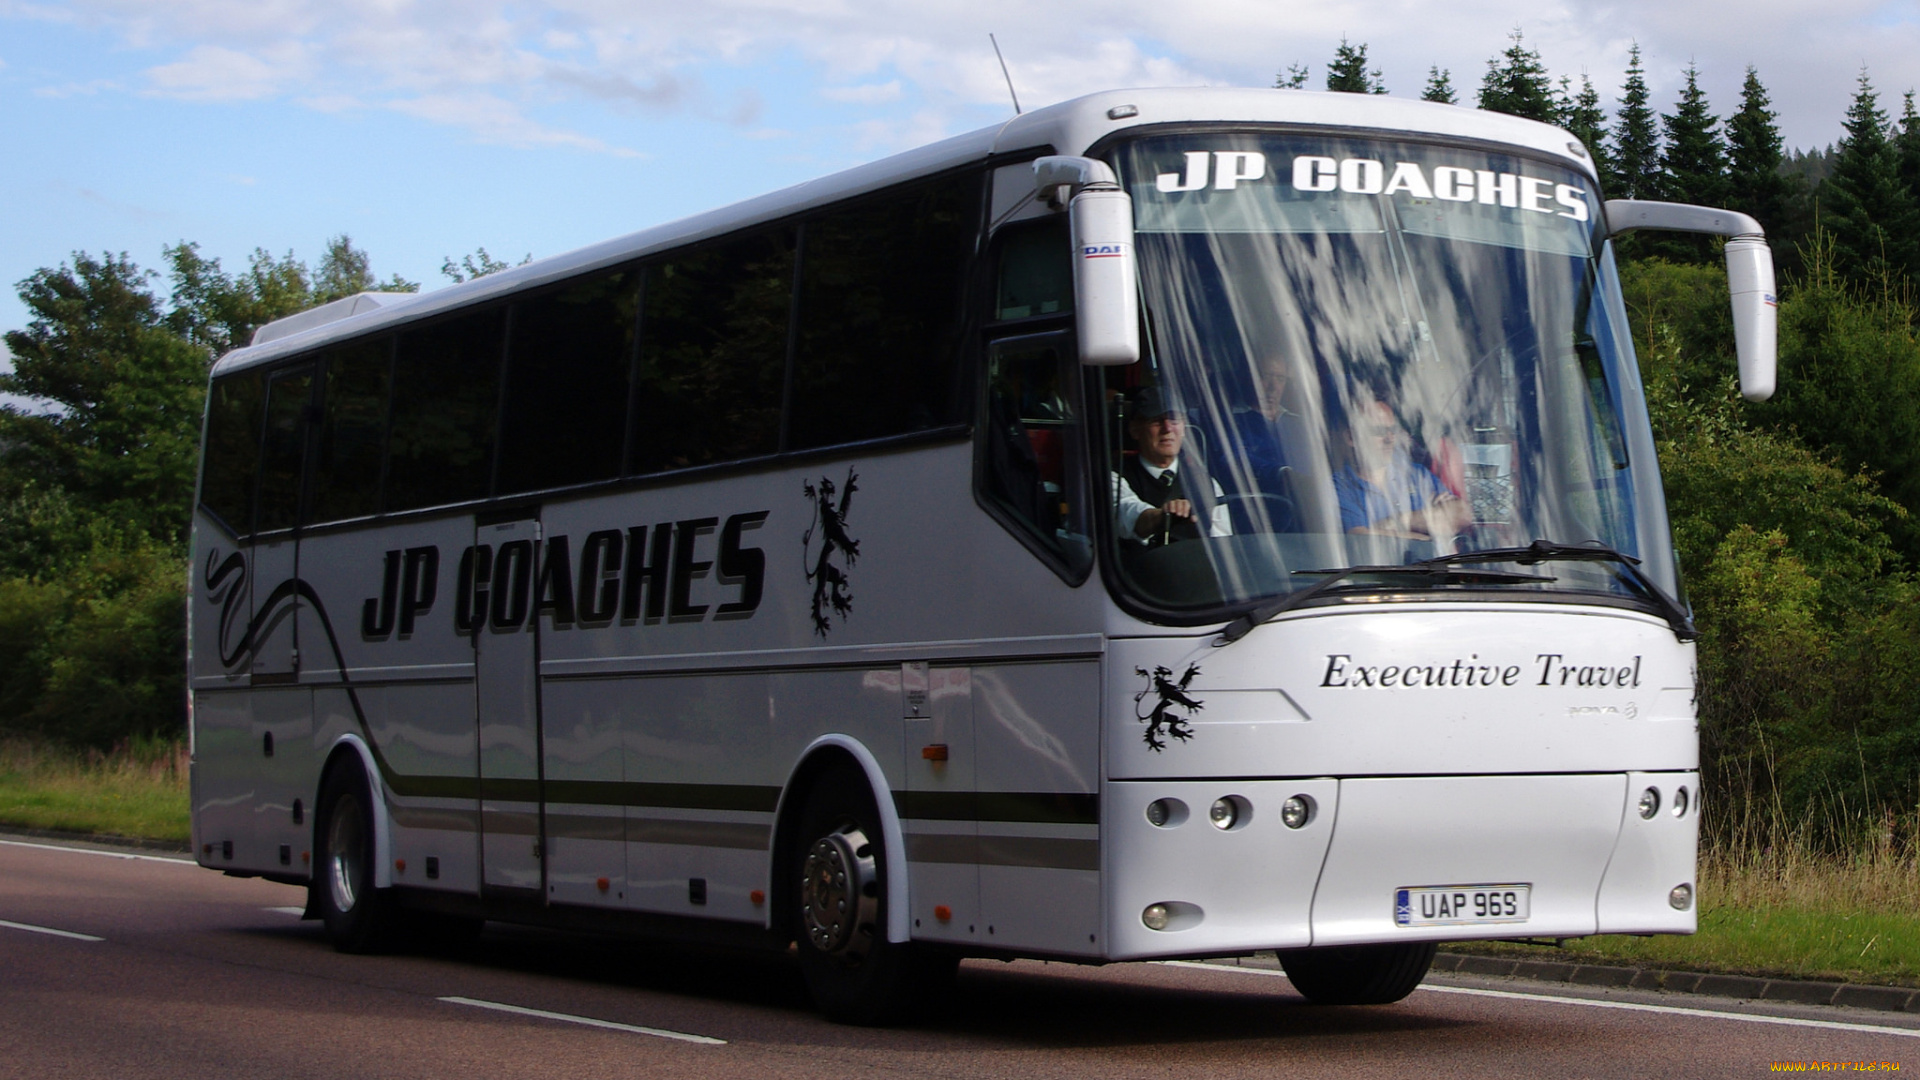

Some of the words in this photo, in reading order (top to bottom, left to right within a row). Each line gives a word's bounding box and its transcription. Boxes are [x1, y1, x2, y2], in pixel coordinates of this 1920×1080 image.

[1156, 151, 1266, 193] JP
[1292, 155, 1589, 222] COACHES
[361, 544, 440, 642] JP
[454, 510, 770, 636] COACHES
[1319, 654, 1521, 689] Executive
[1535, 654, 1643, 688] Travel
[1421, 892, 1467, 919] UAP
